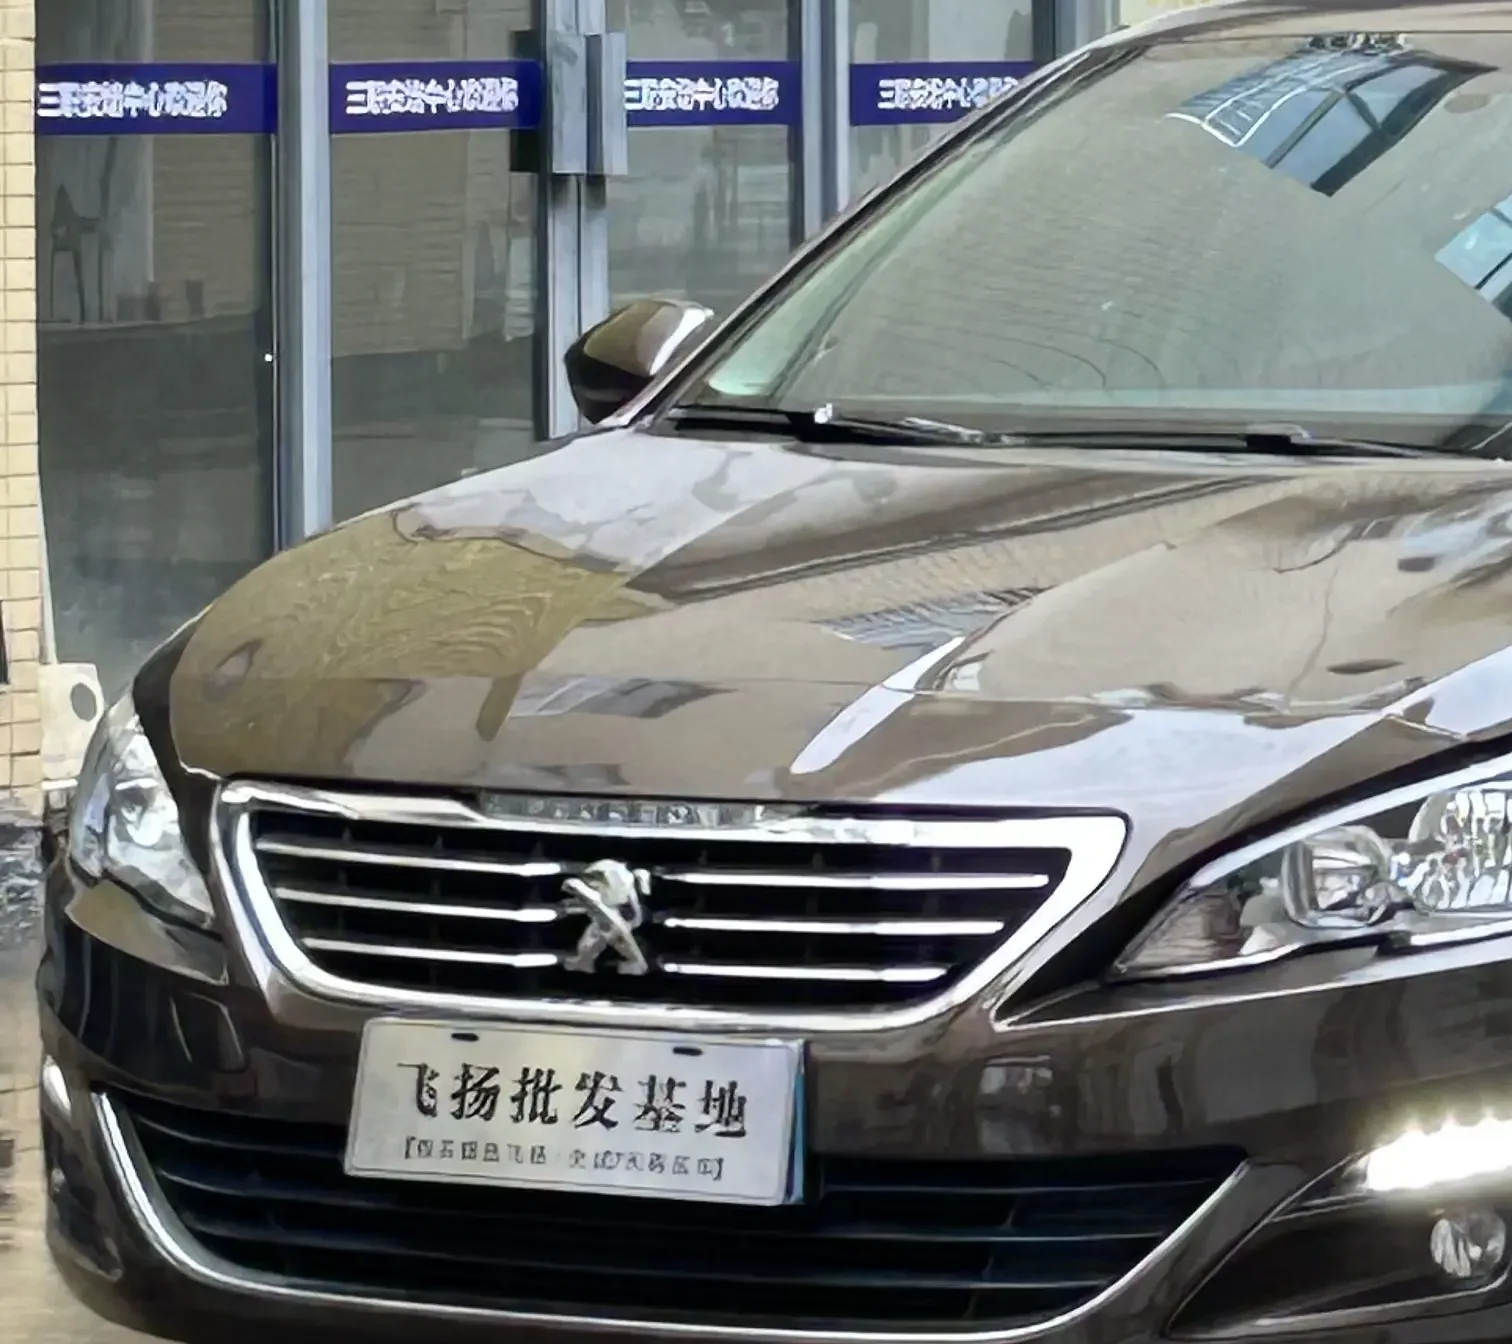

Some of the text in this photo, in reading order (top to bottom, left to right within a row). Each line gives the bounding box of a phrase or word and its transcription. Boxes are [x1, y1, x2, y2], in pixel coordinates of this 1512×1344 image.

[397, 1061, 748, 1138] 飞扬批发基地
